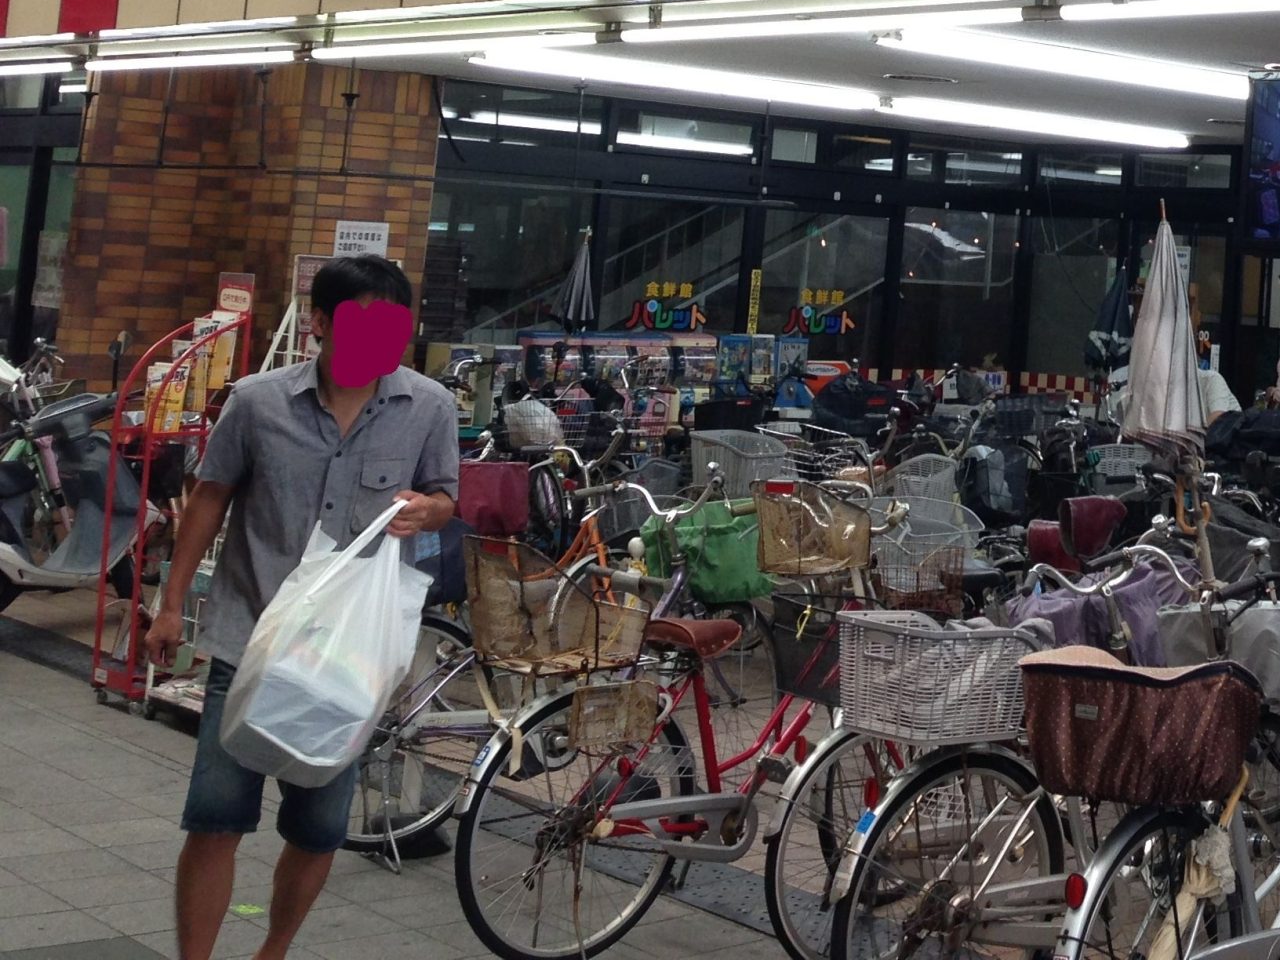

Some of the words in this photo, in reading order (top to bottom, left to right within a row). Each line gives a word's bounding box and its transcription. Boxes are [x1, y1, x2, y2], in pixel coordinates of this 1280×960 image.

[625, 299, 708, 332] パレット
[783, 305, 856, 336] パレット
